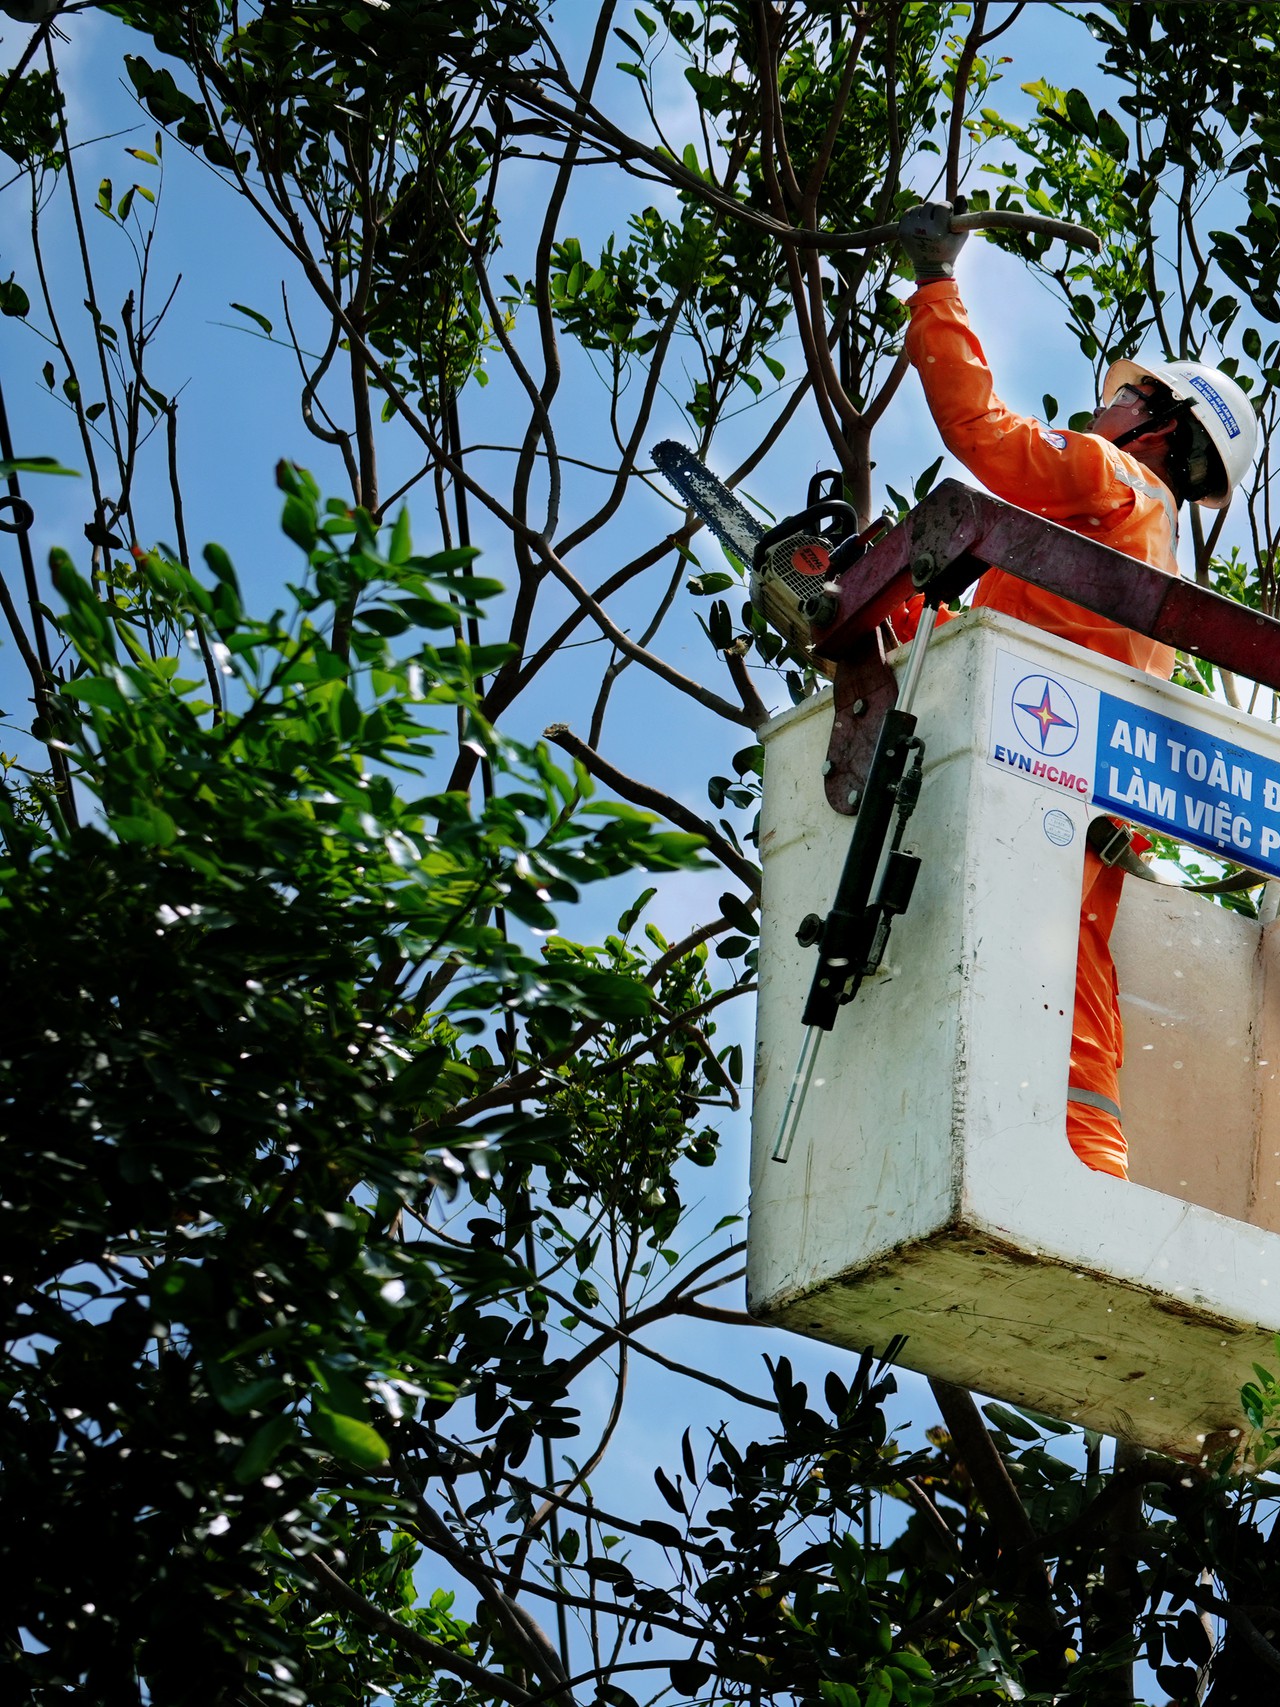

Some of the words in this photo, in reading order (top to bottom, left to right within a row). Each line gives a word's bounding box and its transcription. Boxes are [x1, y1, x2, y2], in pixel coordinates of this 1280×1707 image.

[802, 548, 823, 570] STIHL
[994, 744, 1089, 794] EVNHCMC
[1110, 720, 1157, 763] AN
[1167, 738, 1253, 802] TOÀN
[1108, 766, 1177, 821] LÀM
[1184, 794, 1253, 848] VIỆC
